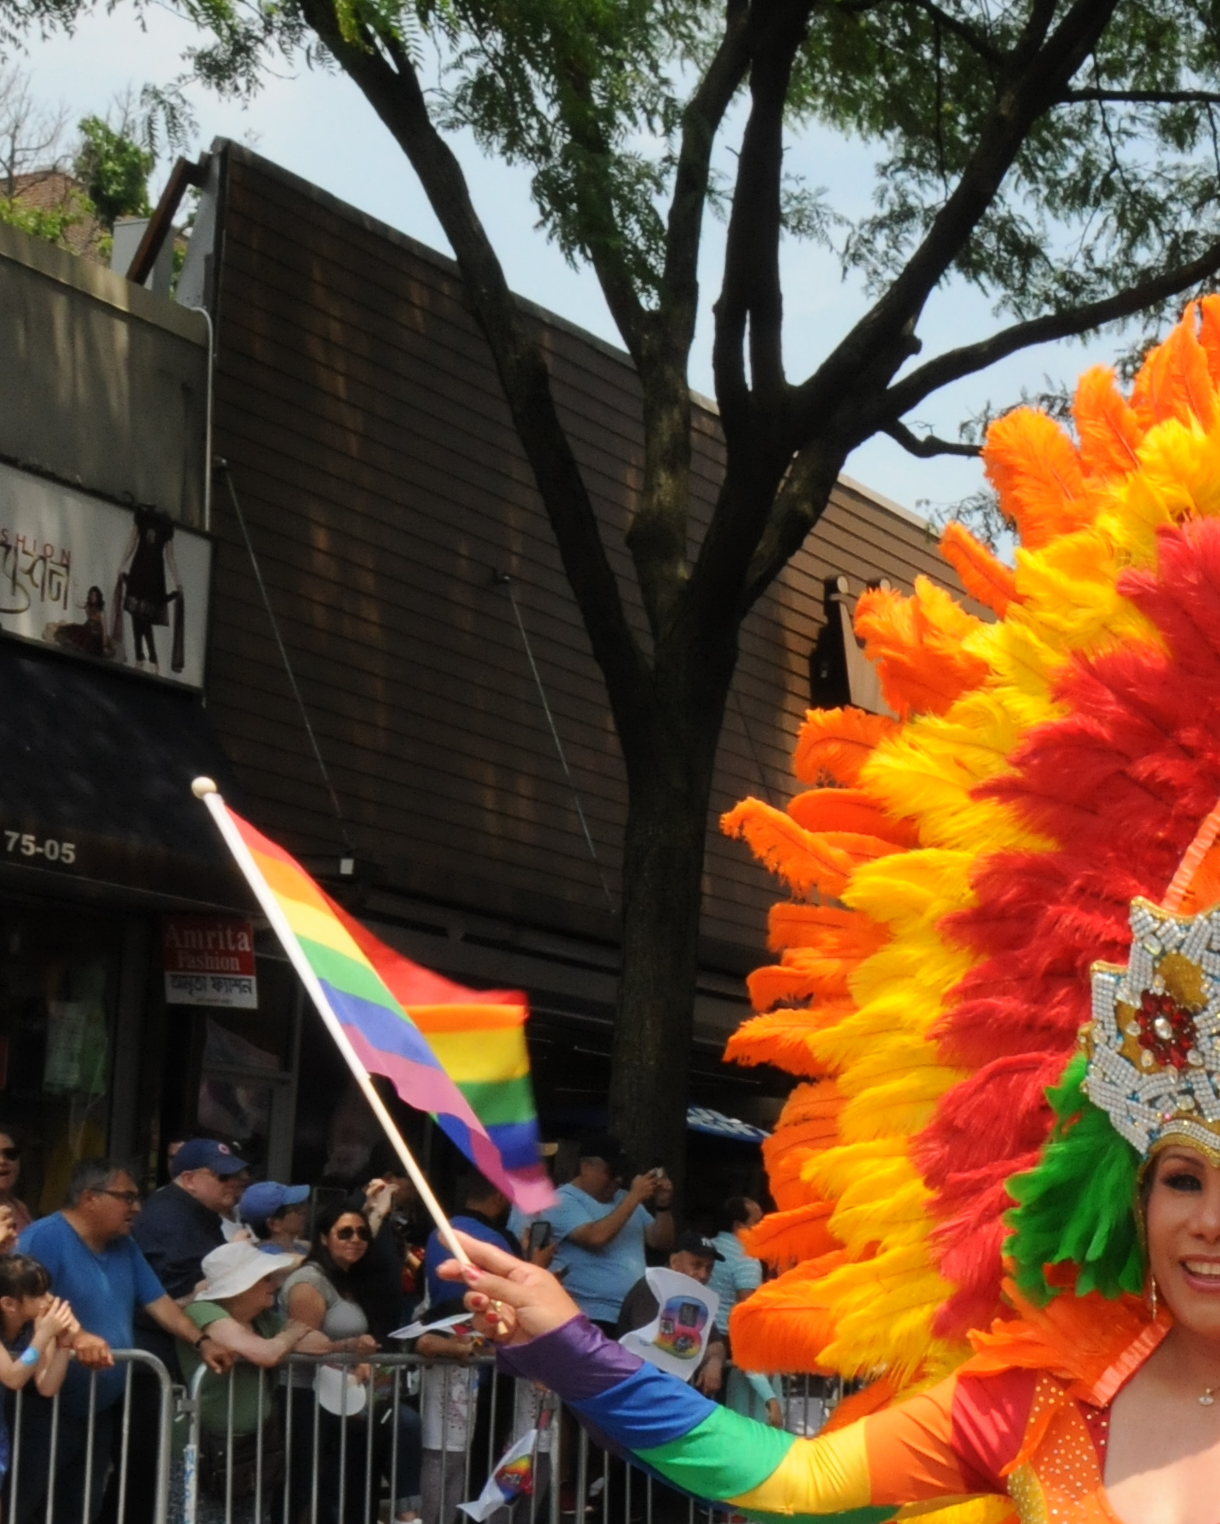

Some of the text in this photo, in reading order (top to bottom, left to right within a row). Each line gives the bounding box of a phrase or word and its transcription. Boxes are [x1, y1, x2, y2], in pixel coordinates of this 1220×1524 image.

[4, 830, 76, 864] 75-05
[164, 923, 251, 952] Amrita
[176, 949, 241, 972] Fashion
